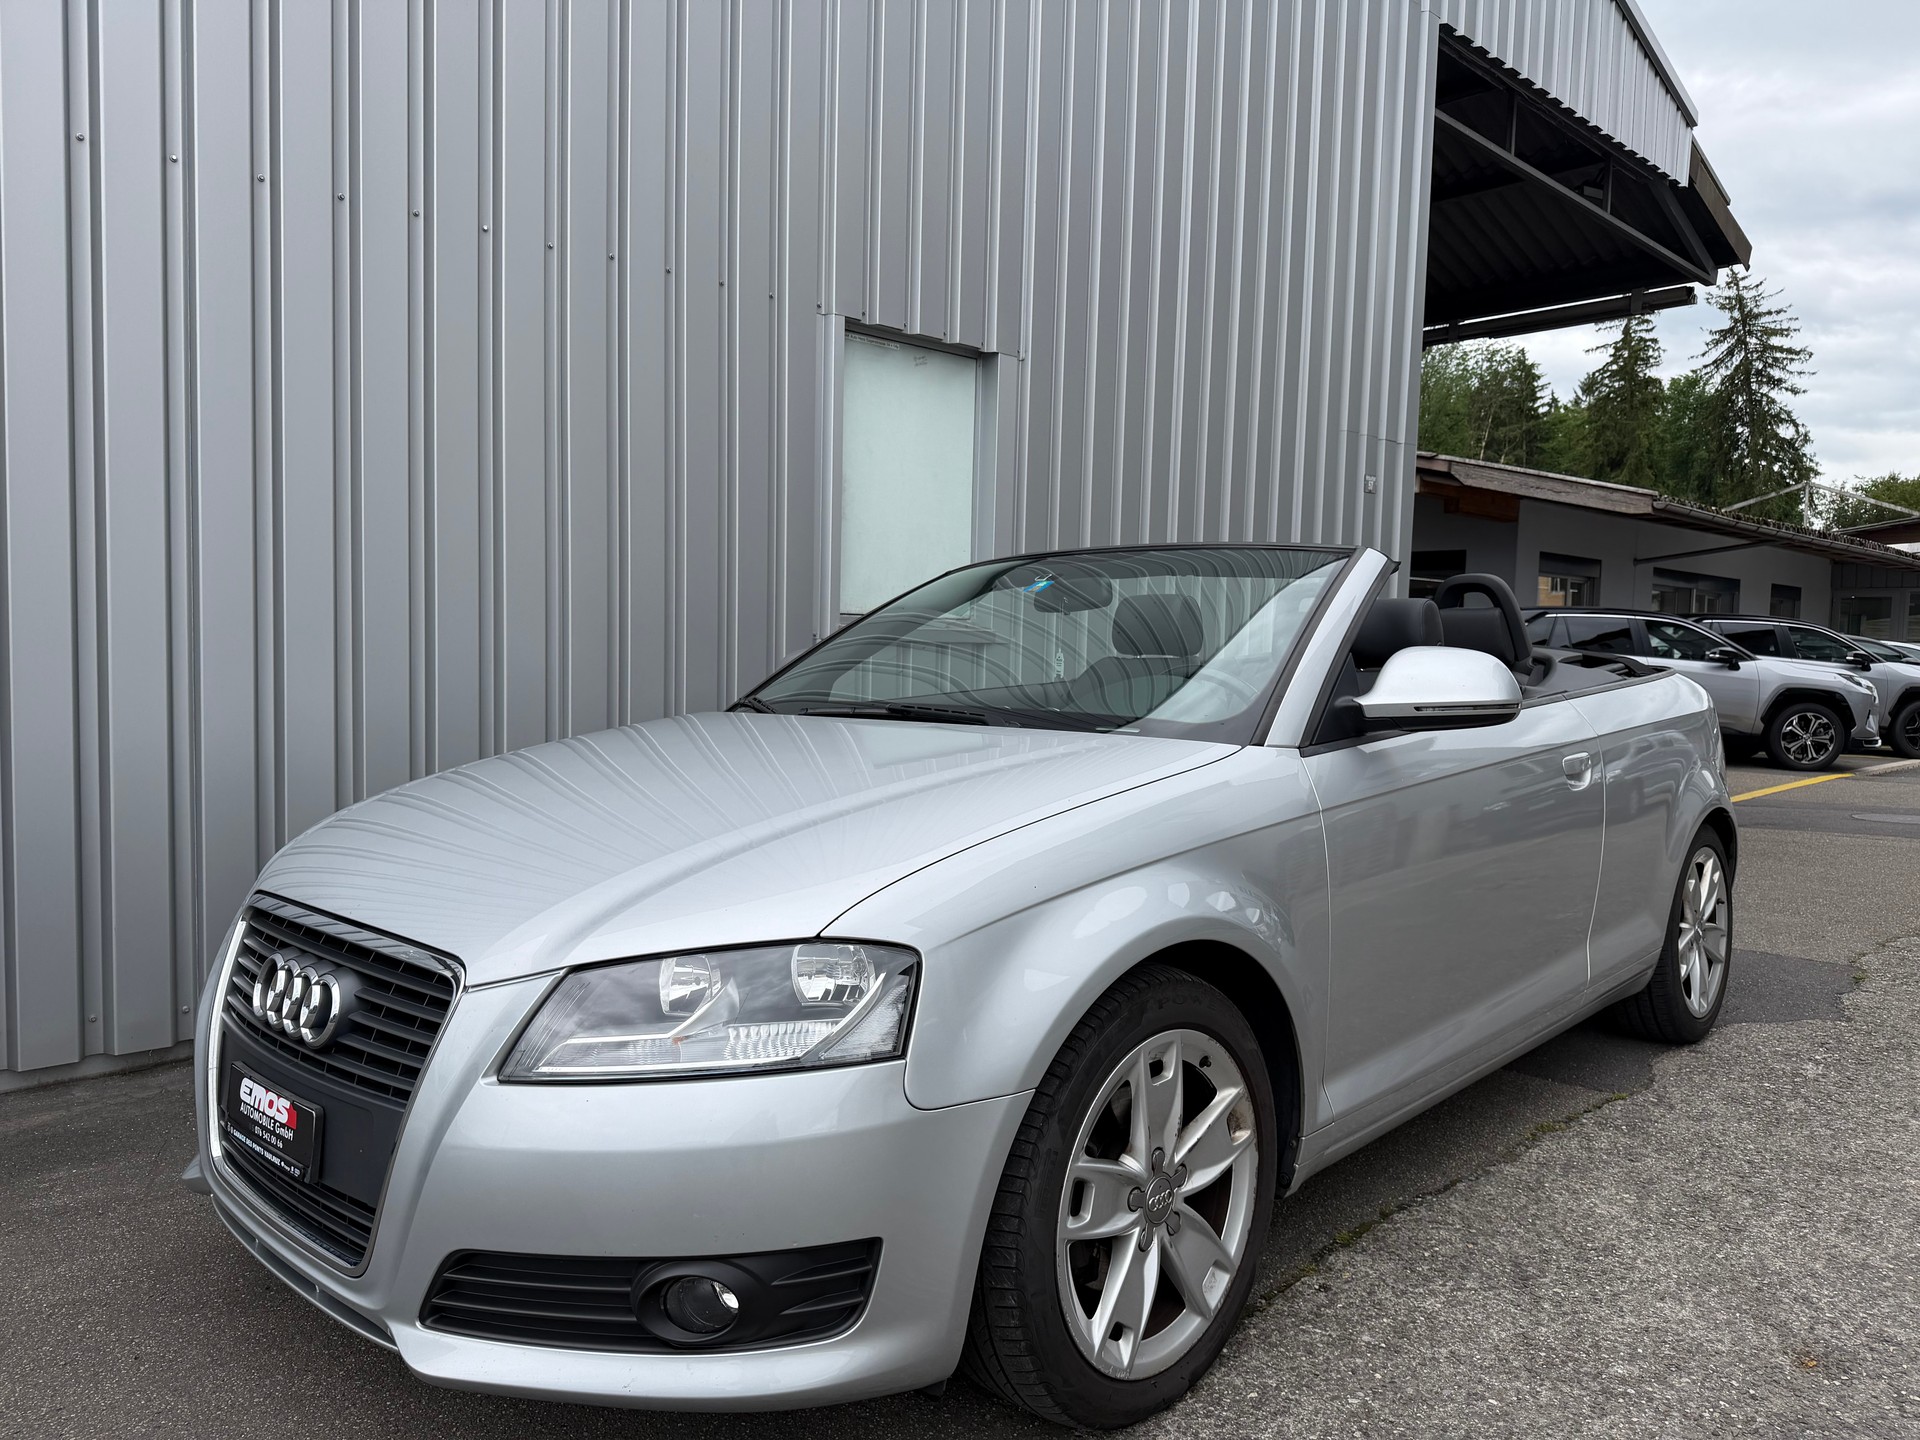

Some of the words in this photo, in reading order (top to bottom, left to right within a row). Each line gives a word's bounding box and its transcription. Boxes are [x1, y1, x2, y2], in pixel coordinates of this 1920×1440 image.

[240, 1077, 291, 1124] EMOS
[240, 1102, 274, 1131] AUTOMOBILE
[275, 1122, 294, 1141] GmbH
[262, 1131, 270, 1141] 542
